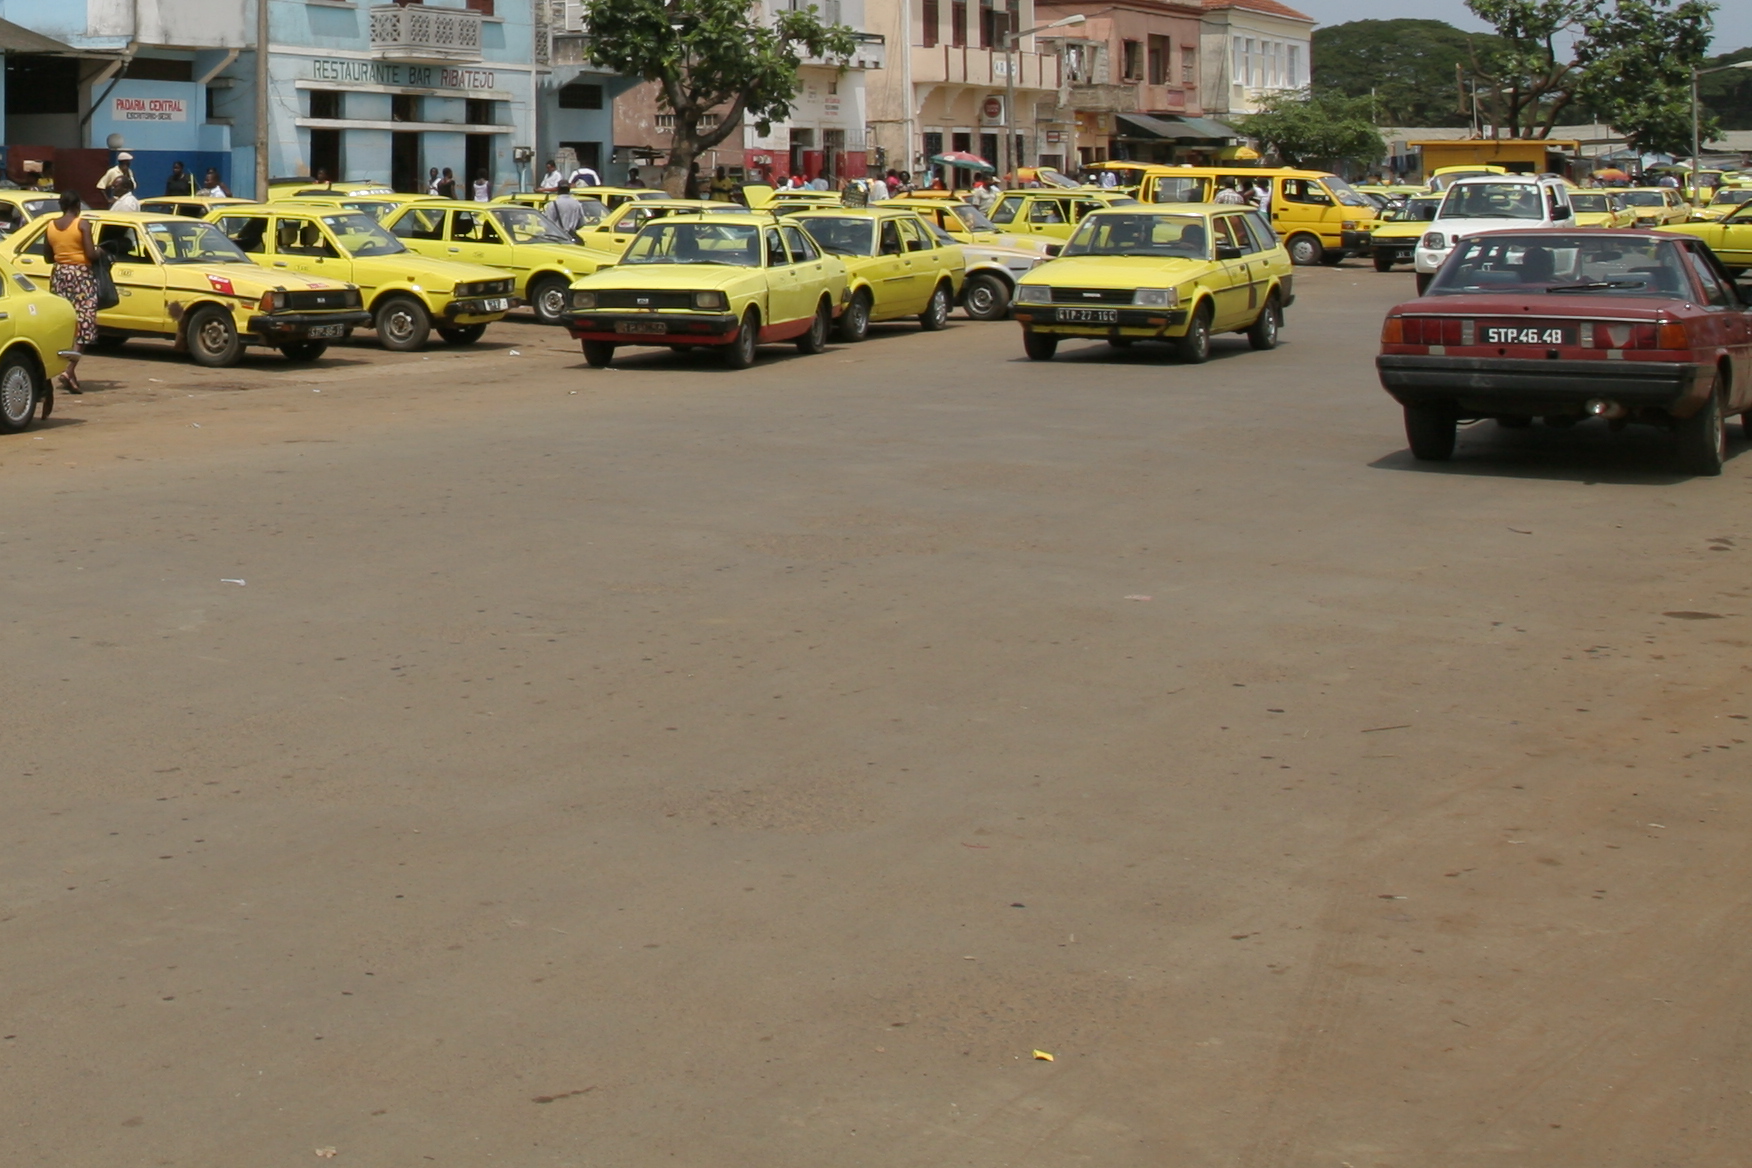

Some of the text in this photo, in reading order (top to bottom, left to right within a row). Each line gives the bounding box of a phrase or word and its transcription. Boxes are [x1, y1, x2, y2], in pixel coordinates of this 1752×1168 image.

[313, 60, 495, 89] RESTAURANTE BAR RIBATEJO
[116, 99, 182, 112] PADARIA CENTRAL
